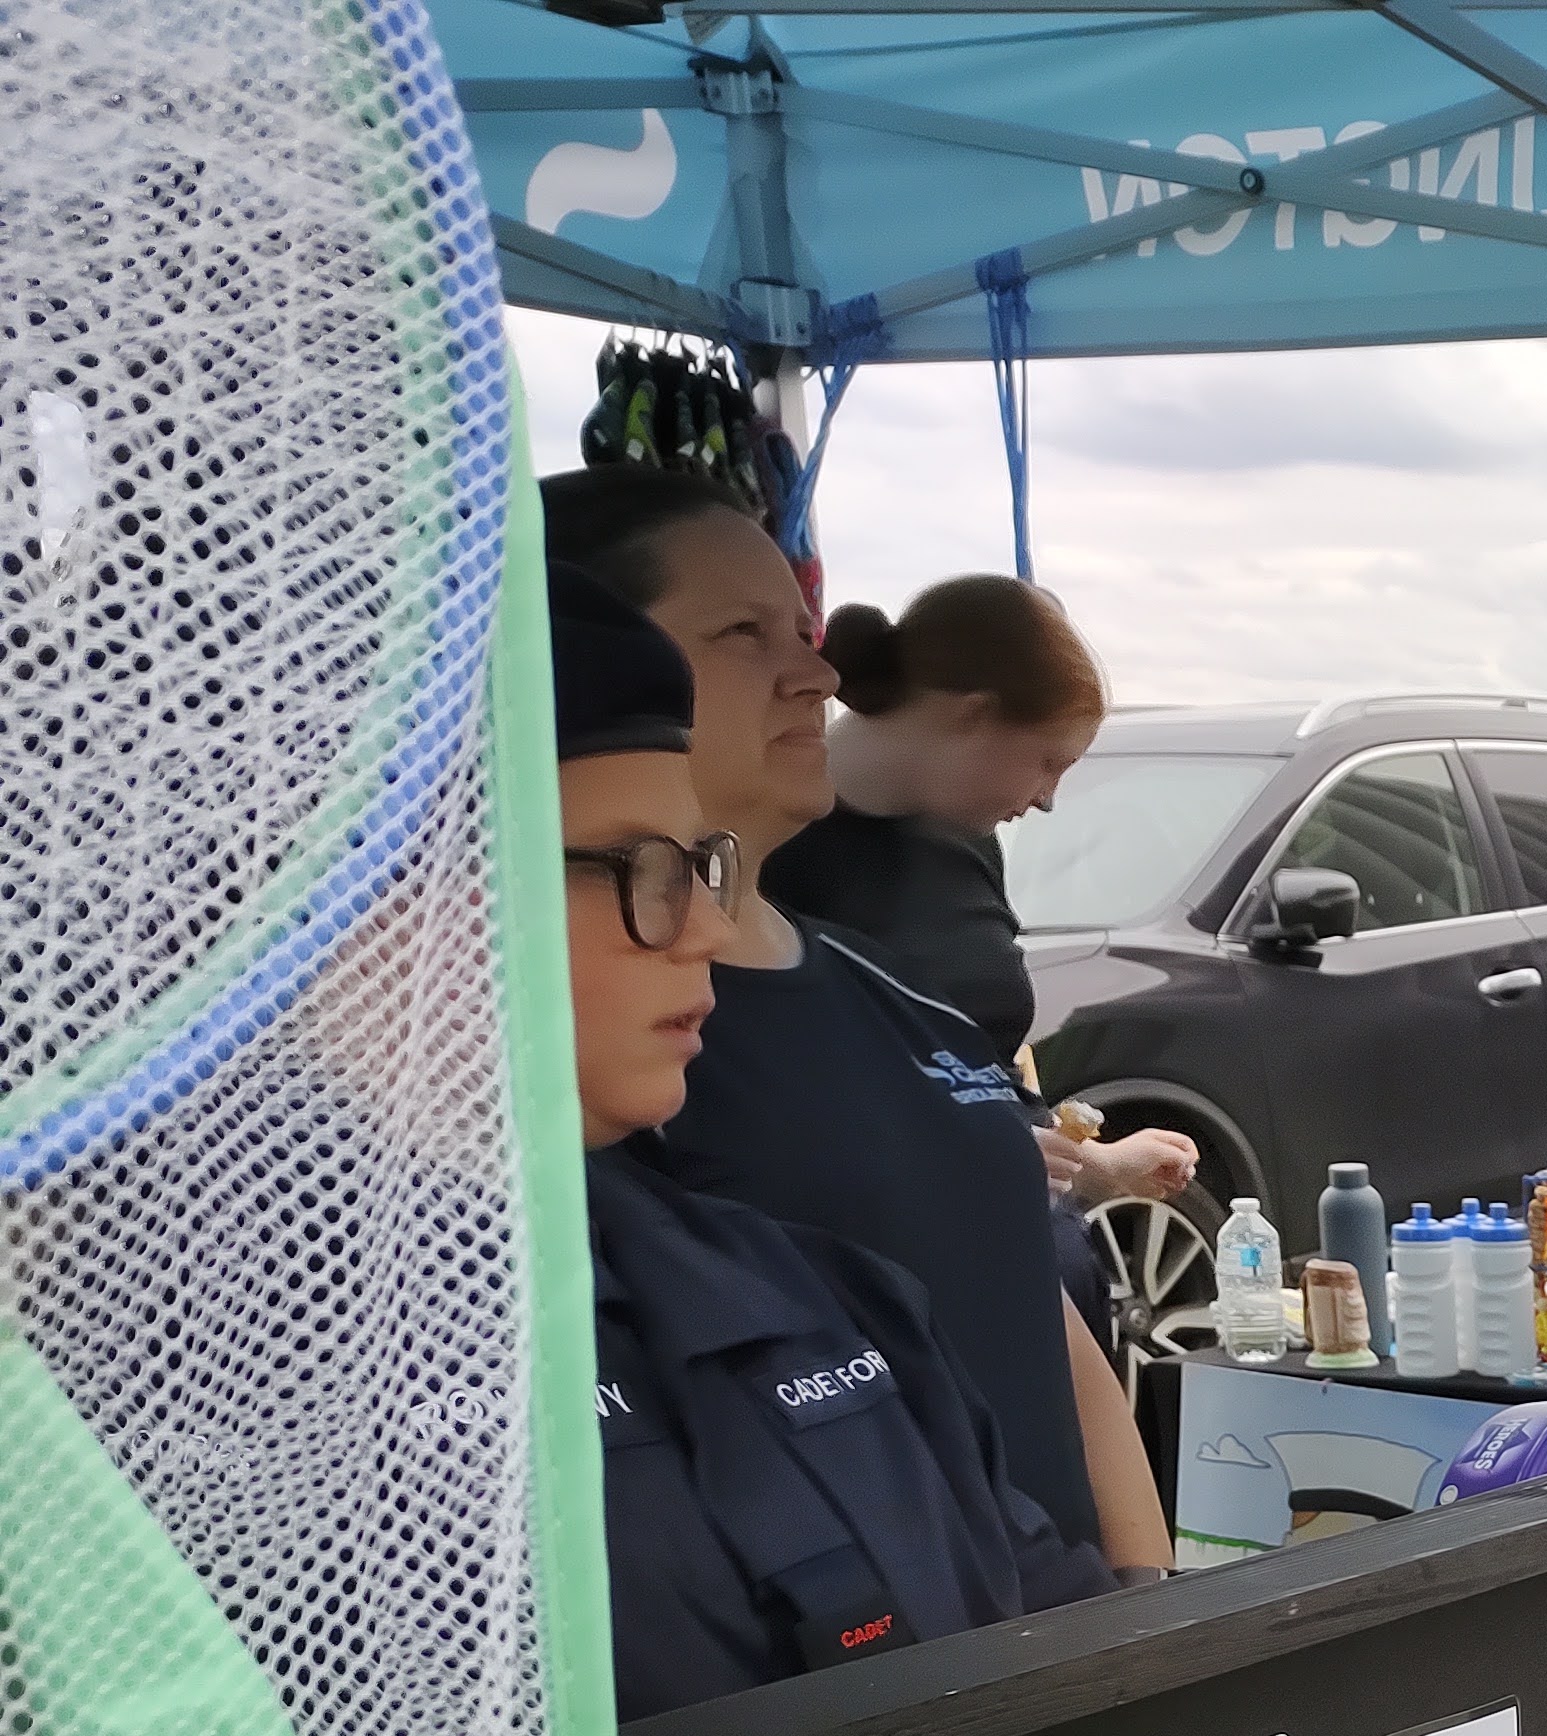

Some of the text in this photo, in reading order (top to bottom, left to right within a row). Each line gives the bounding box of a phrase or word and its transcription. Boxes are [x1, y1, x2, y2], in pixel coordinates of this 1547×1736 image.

[775, 1350, 891, 1409] CADET FOR
[1474, 1418, 1528, 1470] HEROES
[841, 1613, 893, 1648] CADET
